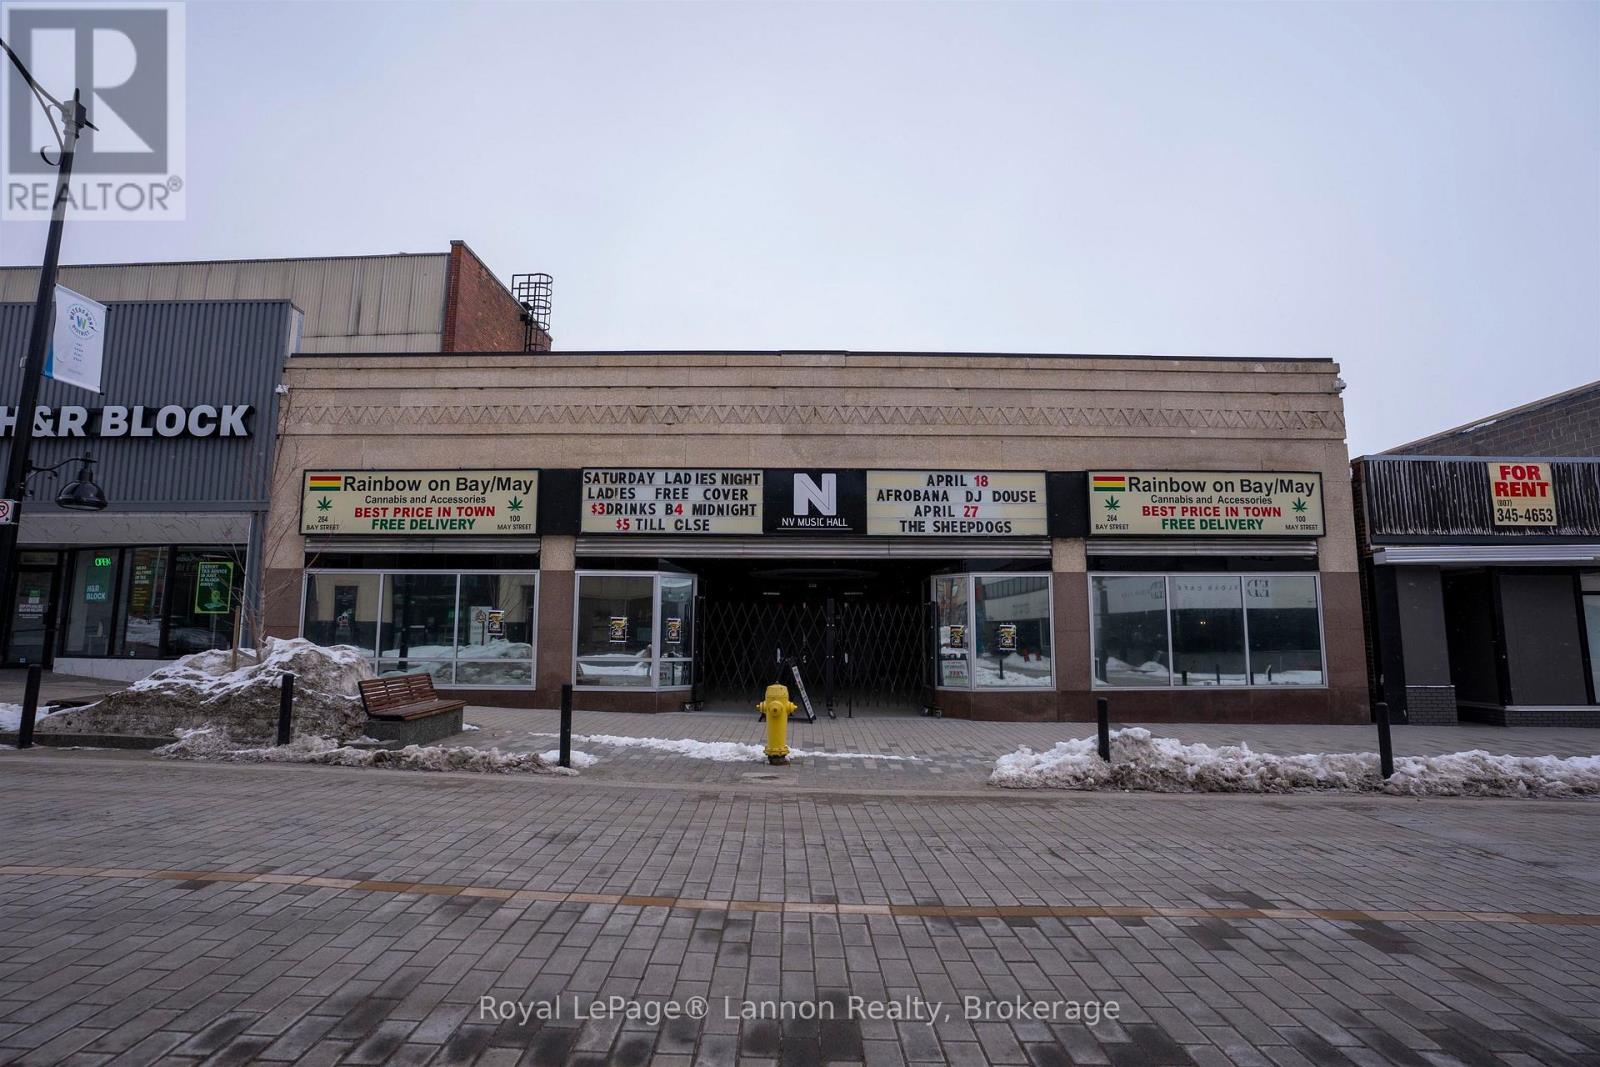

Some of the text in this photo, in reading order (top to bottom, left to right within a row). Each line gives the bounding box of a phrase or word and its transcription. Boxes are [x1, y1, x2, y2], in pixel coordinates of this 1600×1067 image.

[0, 404, 250, 437] H&R BLOCK
[583, 472, 761, 485] SATURDAY LADIES NIGHT
[1499, 465, 1541, 480] FOR
[343, 476, 533, 495] Rainbow on Bay/May
[926, 475, 989, 487] APRIL 18
[1128, 477, 1315, 497] Rainbow on Bay/May
[588, 487, 749, 501] LADIES FREE COVER
[793, 473, 837, 516] N
[876, 489, 1037, 503] AFROBANA DJ DOUSE
[1494, 482, 1549, 497] RENT
[365, 494, 486, 504] Cannabis and Accessories
[1150, 494, 1273, 505] Cannabis and Accessories
[354, 506, 496, 518] BEST PRICE IN TOWN
[665, 503, 684, 516] B4
[692, 503, 757, 516] MIDNIGHT
[914, 505, 979, 518] APRIL 27
[1142, 506, 1282, 517] BEST PRICE IN TOWN
[1497, 508, 1554, 522] 345-4653
[371, 519, 476, 530] FREE DELIVERY
[615, 518, 631, 531] $5
[635, 518, 666, 531] TILL
[781, 517, 849, 527] NV MUSIC HALL
[899, 520, 1012, 534] THE SHEEPDOGS
[1161, 519, 1264, 530] FREE DELIVERY
[94, 557, 111, 567] OPEN
